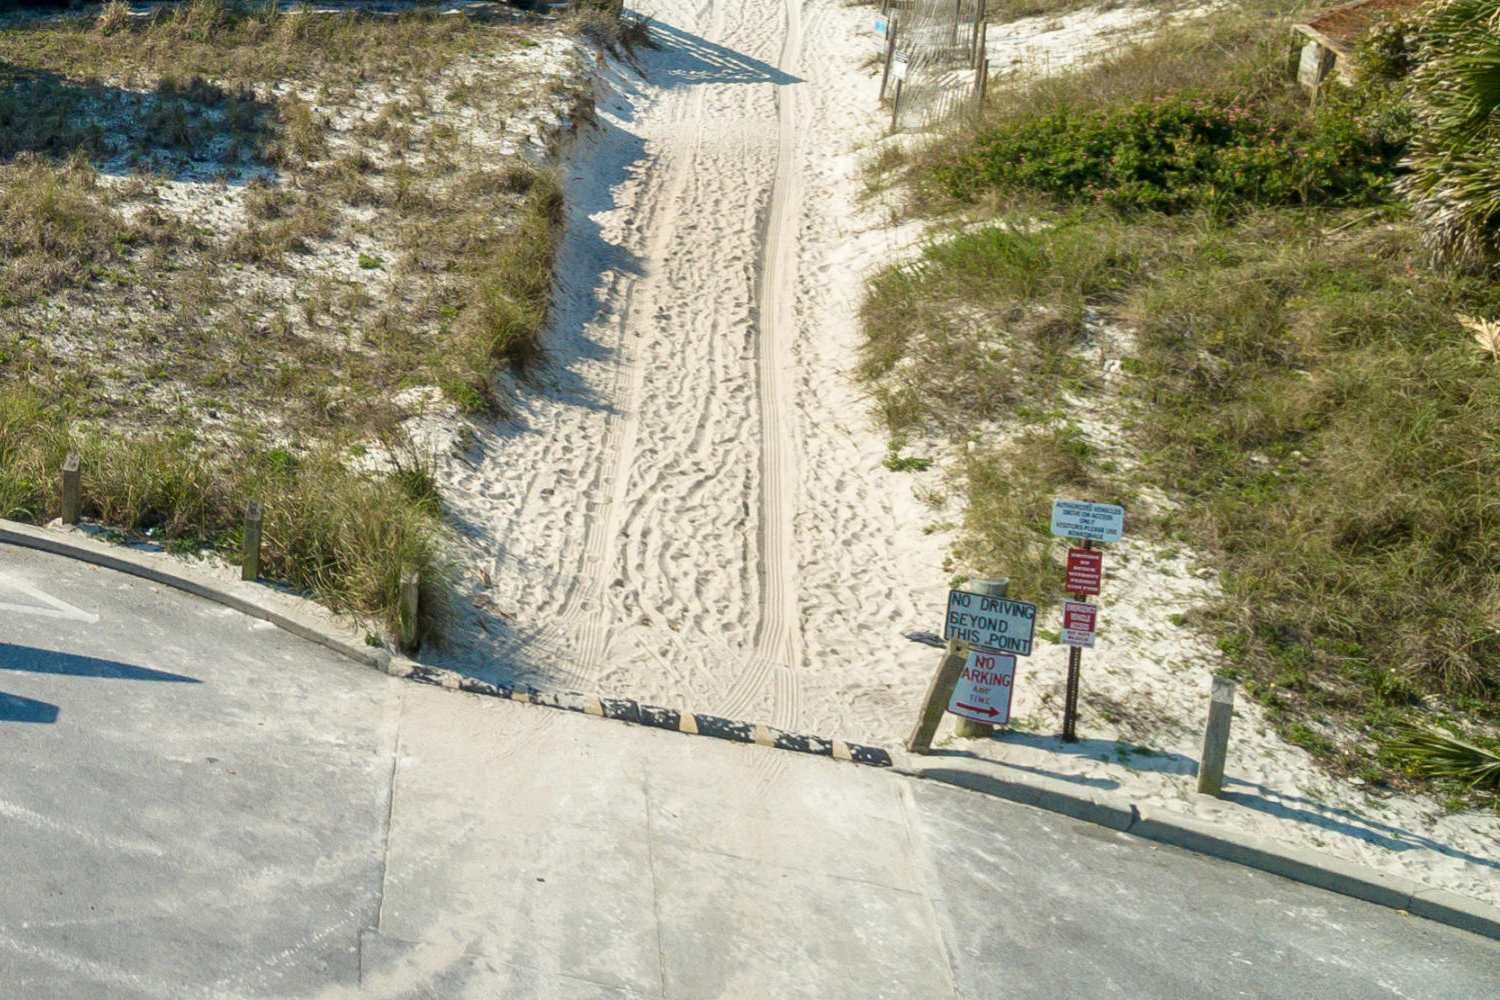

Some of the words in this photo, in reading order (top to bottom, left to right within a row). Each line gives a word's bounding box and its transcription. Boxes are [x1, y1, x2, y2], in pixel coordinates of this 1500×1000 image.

[951, 593, 971, 608] NO
[980, 597, 1034, 620] DRIVING
[950, 611, 1009, 633] BEYOND
[950, 625, 980, 643] THIS
[988, 632, 1029, 652] POINT
[975, 655, 996, 670] NO
[961, 667, 1012, 687] ARKING
[970, 694, 990, 705] TIME
